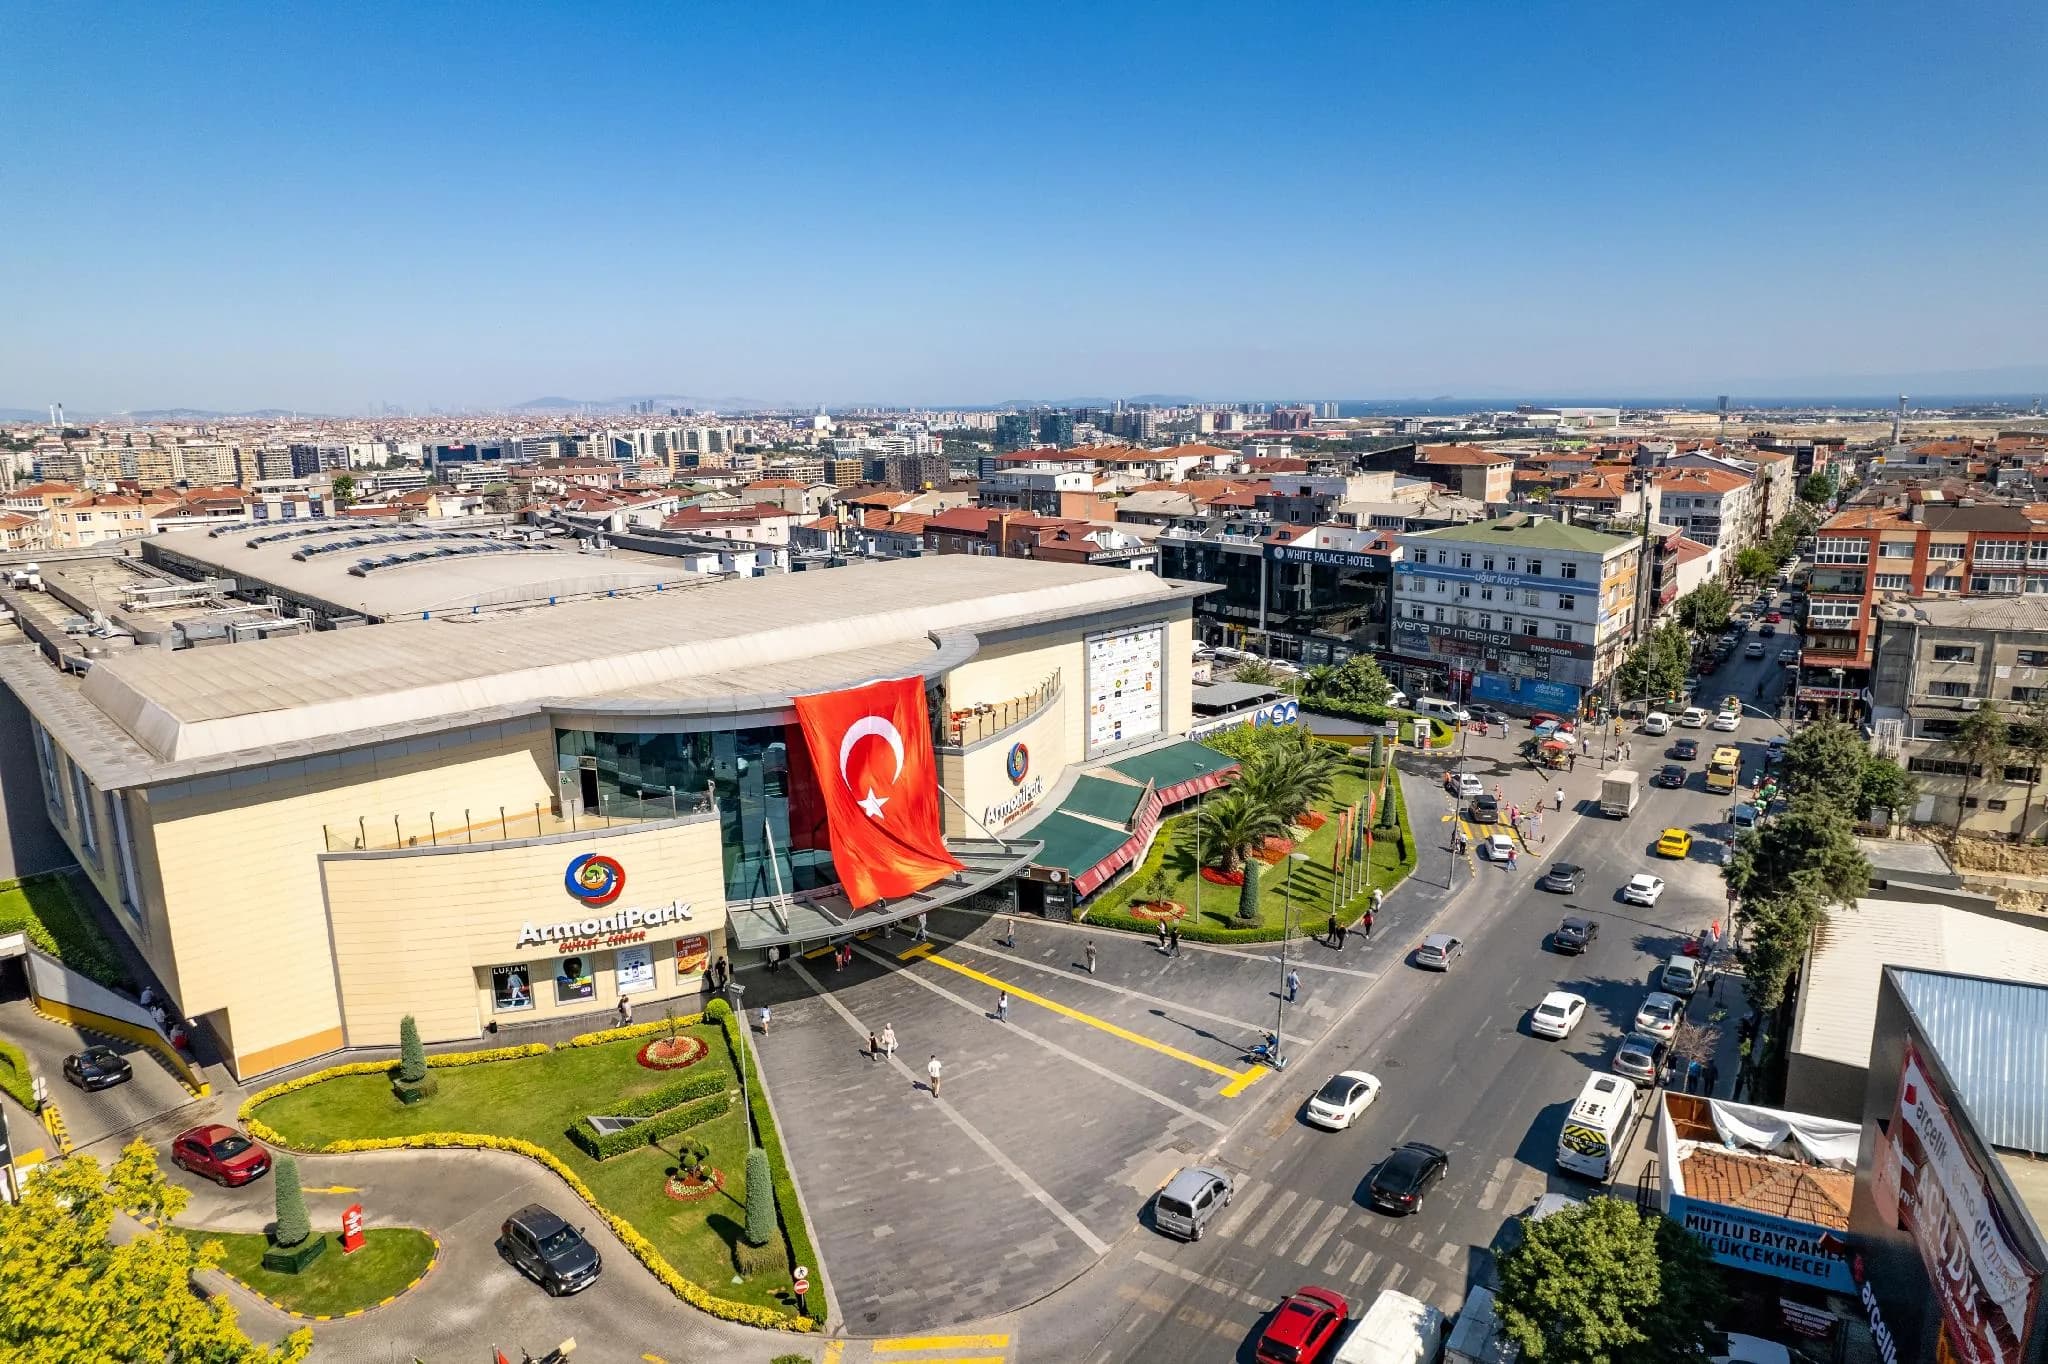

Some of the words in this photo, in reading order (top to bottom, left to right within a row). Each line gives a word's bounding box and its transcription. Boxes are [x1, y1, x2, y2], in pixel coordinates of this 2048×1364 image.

[1287, 548, 1312, 561] WHITE
[1314, 551, 1345, 564] PALACE
[1347, 555, 1375, 568] HOTEL
[1498, 575, 1520, 586] kurs
[518, 901, 692, 944] ArmoniPark
[607, 931, 647, 947] CENTER
[1565, 1134, 1583, 1144] OKUL
[1916, 1101, 1949, 1168] arçelik
[1685, 1213, 1744, 1239] MUTLU
